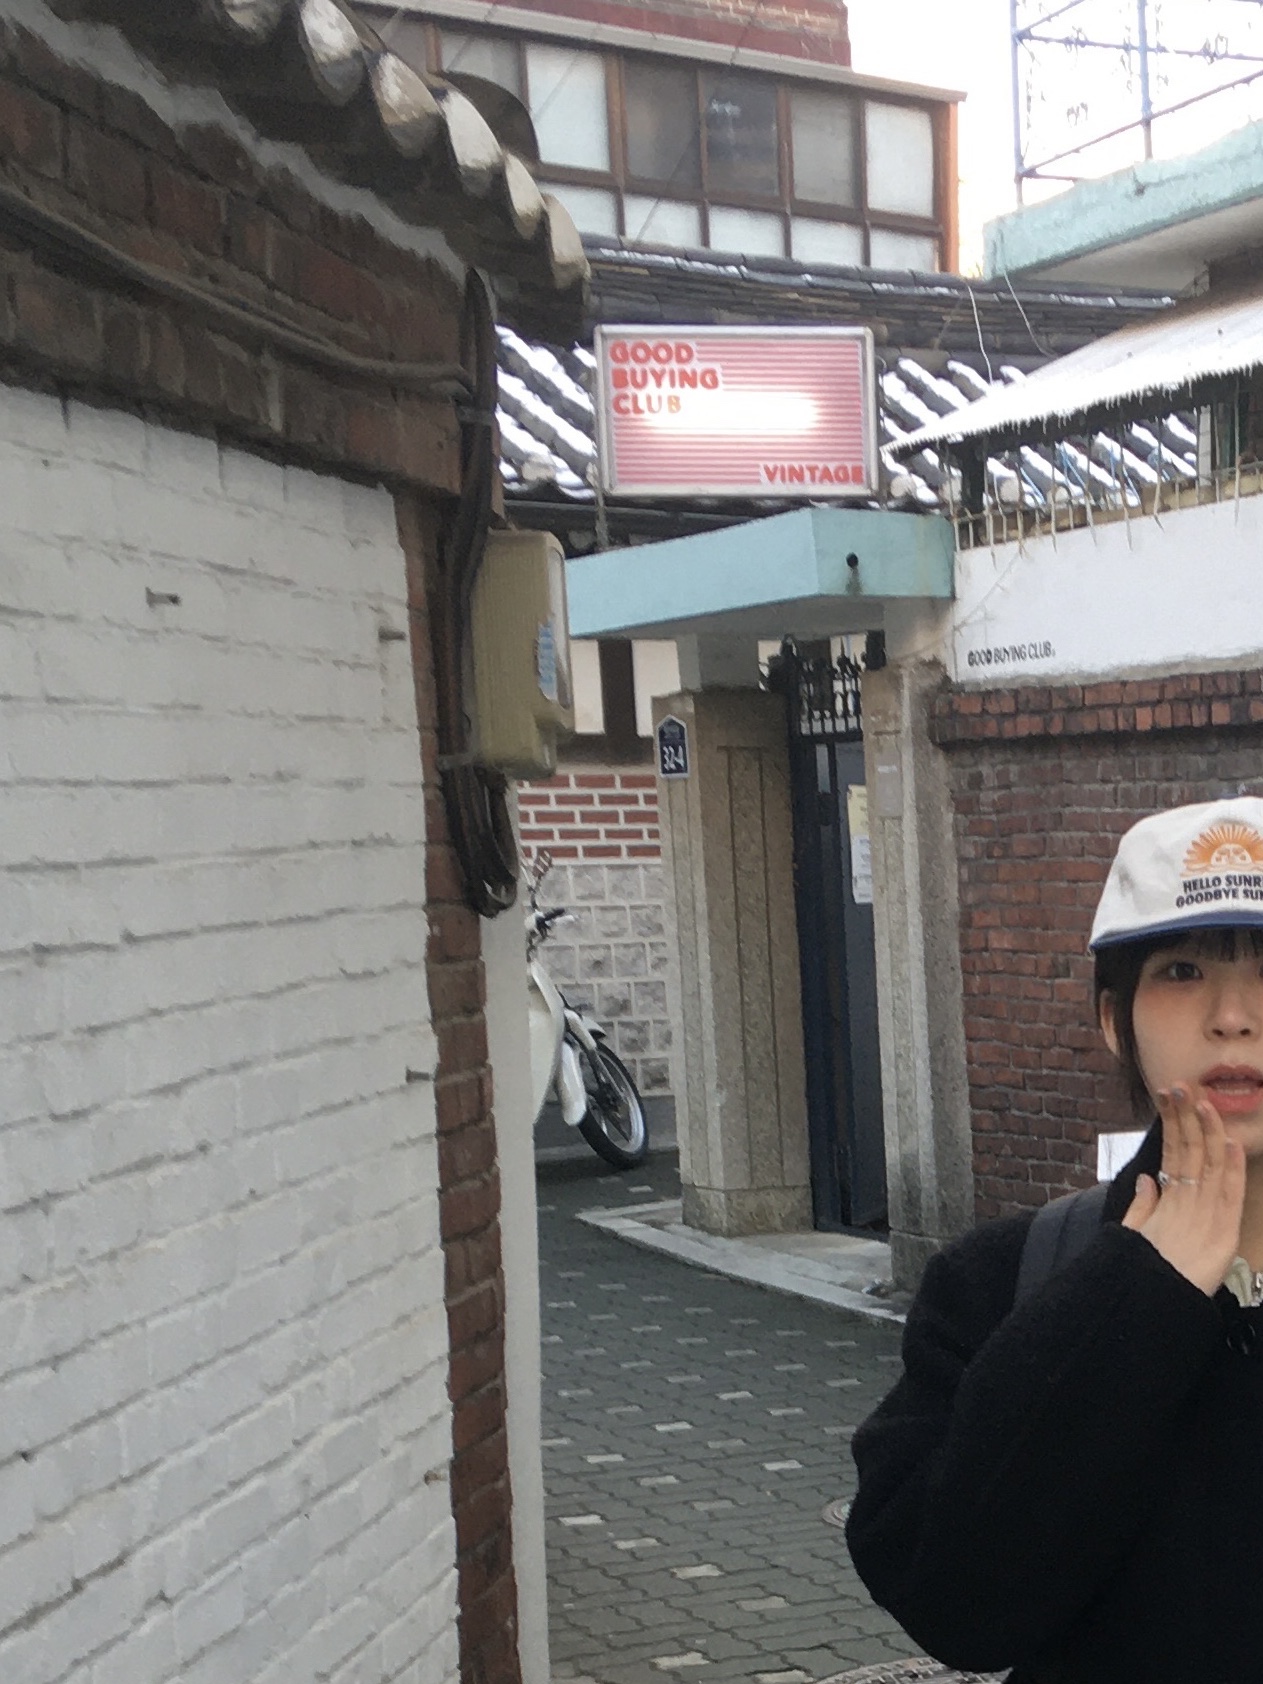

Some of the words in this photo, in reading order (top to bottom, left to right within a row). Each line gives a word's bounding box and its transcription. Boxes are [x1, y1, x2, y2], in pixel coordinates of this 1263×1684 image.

[609, 341, 694, 364] GOOD
[612, 367, 719, 390] BUYING
[613, 393, 682, 415] CLUB
[763, 463, 864, 484] VINTAGE
[968, 648, 992, 667] GOOD
[994, 644, 1027, 664] BUYING
[1183, 875, 1222, 894] HELLO
[1175, 888, 1239, 908] GOODBYE
